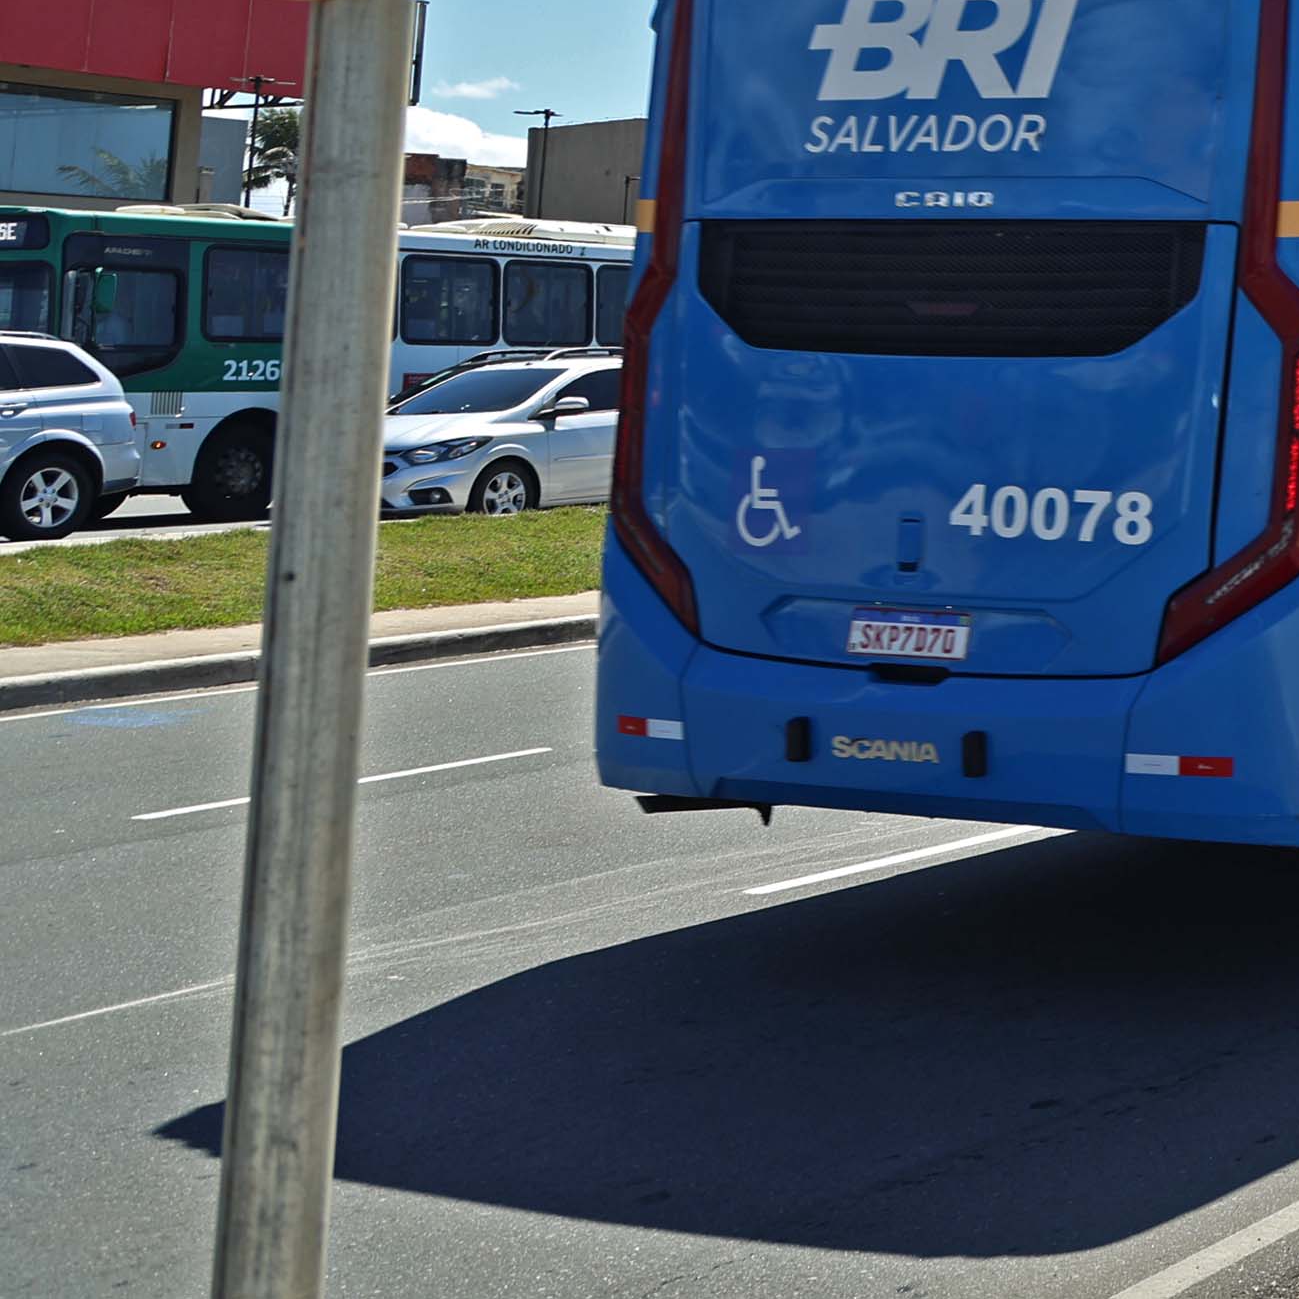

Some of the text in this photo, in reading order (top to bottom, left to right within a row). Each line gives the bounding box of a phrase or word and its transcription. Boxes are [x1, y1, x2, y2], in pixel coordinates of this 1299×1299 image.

[804, 113, 1047, 154] SALVADOR
[474, 237, 574, 255] AR CONDICIONADO
[949, 483, 1153, 545] 40078
[831, 734, 940, 764] SCANIA
